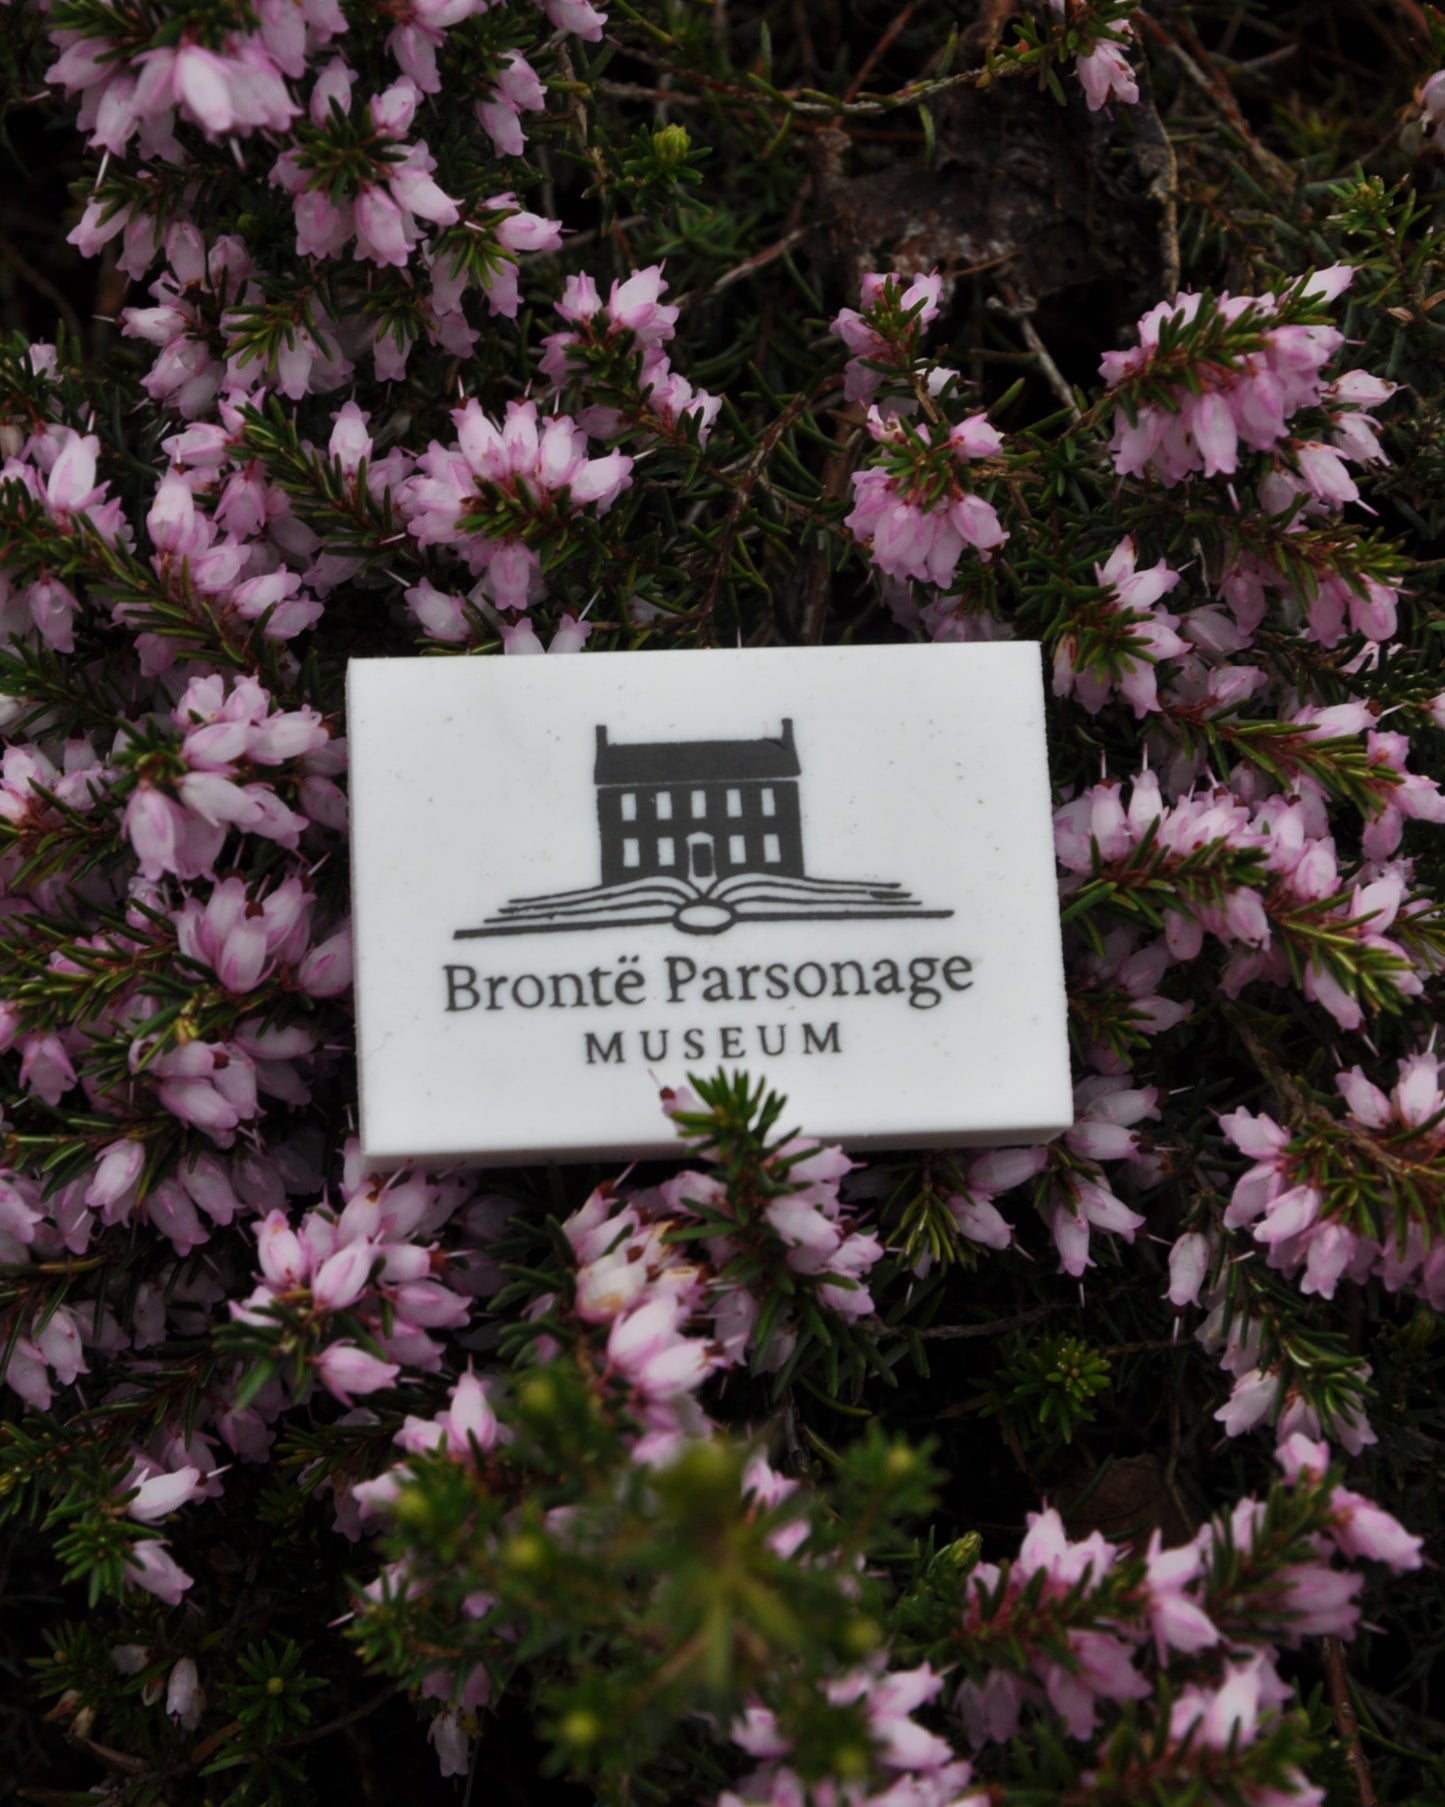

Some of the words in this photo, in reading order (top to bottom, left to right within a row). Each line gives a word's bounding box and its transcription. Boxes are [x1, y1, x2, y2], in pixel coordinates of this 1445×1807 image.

[443, 955, 646, 1013] Brontë
[663, 955, 974, 1011] Parsonage
[584, 1021, 842, 1065] MUSEUM
